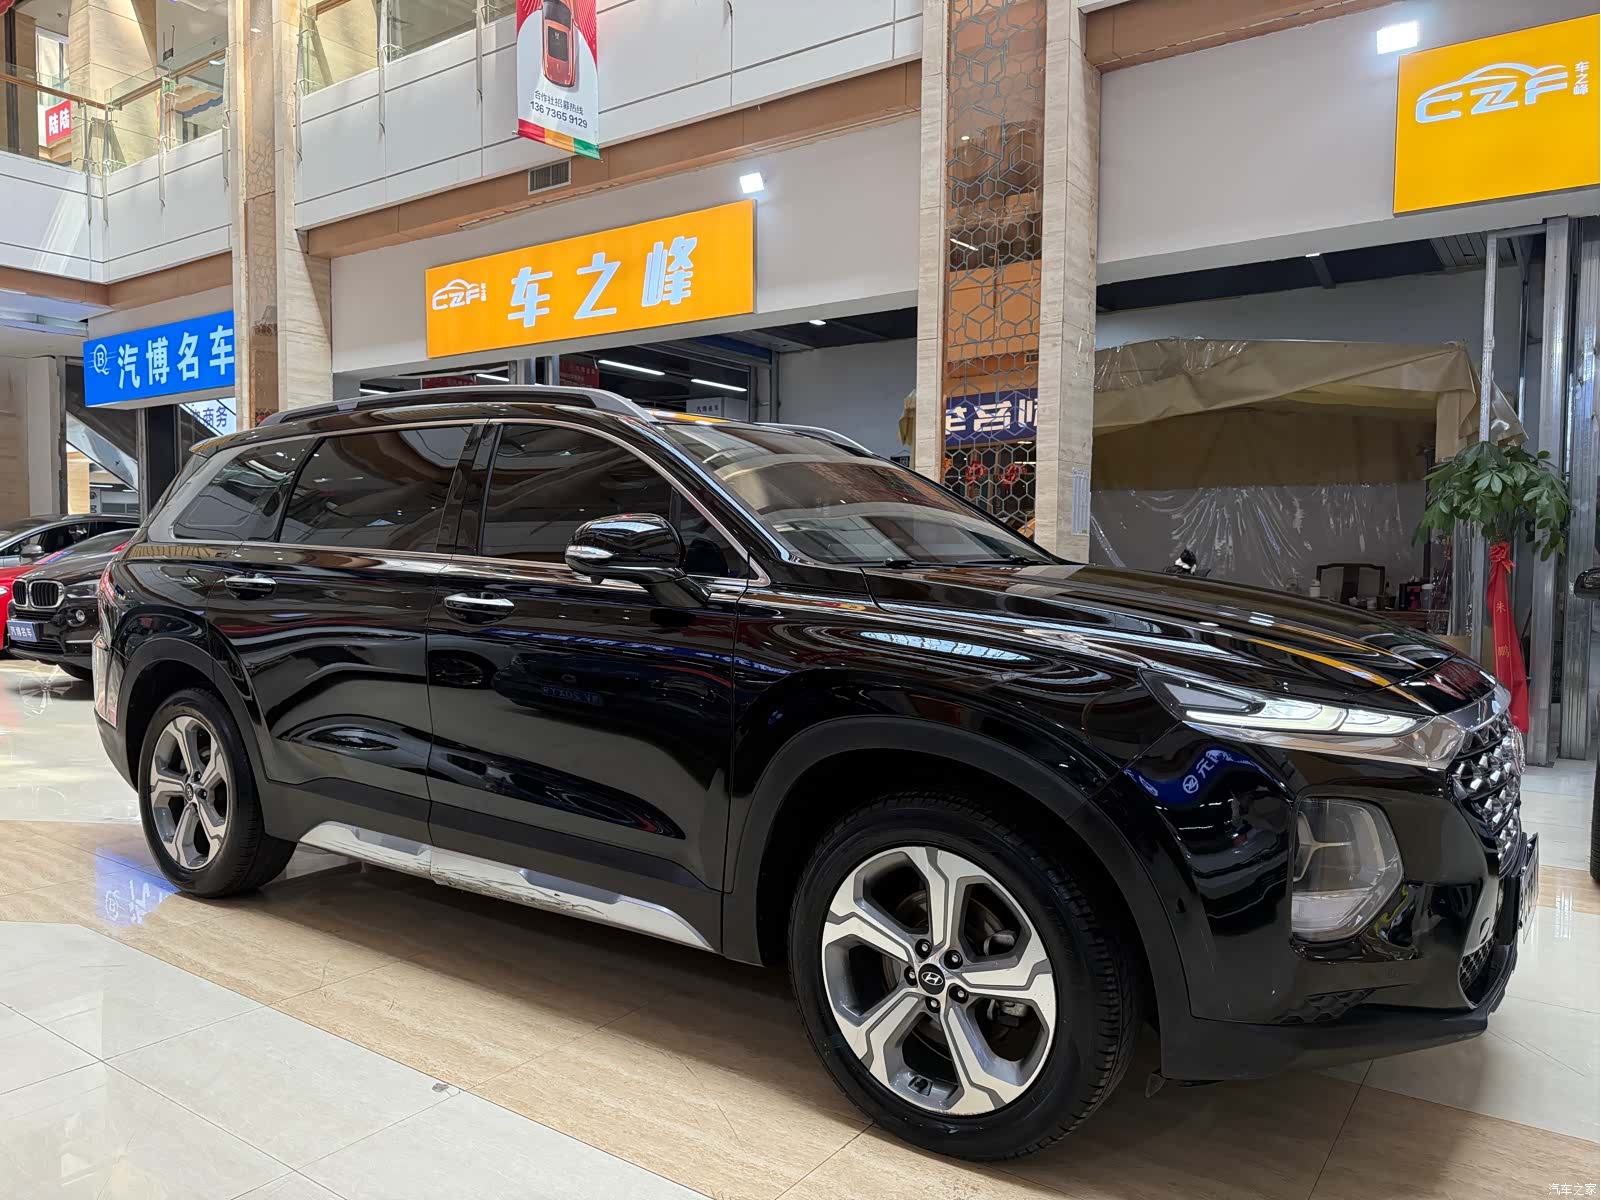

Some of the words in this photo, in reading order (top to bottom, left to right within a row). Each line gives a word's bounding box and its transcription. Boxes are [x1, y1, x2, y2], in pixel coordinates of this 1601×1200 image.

[1573, 61, 1590, 96] 车之峰
[530, 100, 545, 114] 136
[545, 106, 568, 122] 7365
[568, 114, 588, 129] 9129
[534, 89, 584, 116] 合作社招募热线
[507, 236, 698, 328] 车之峰
[117, 324, 235, 390] 汽博名车
